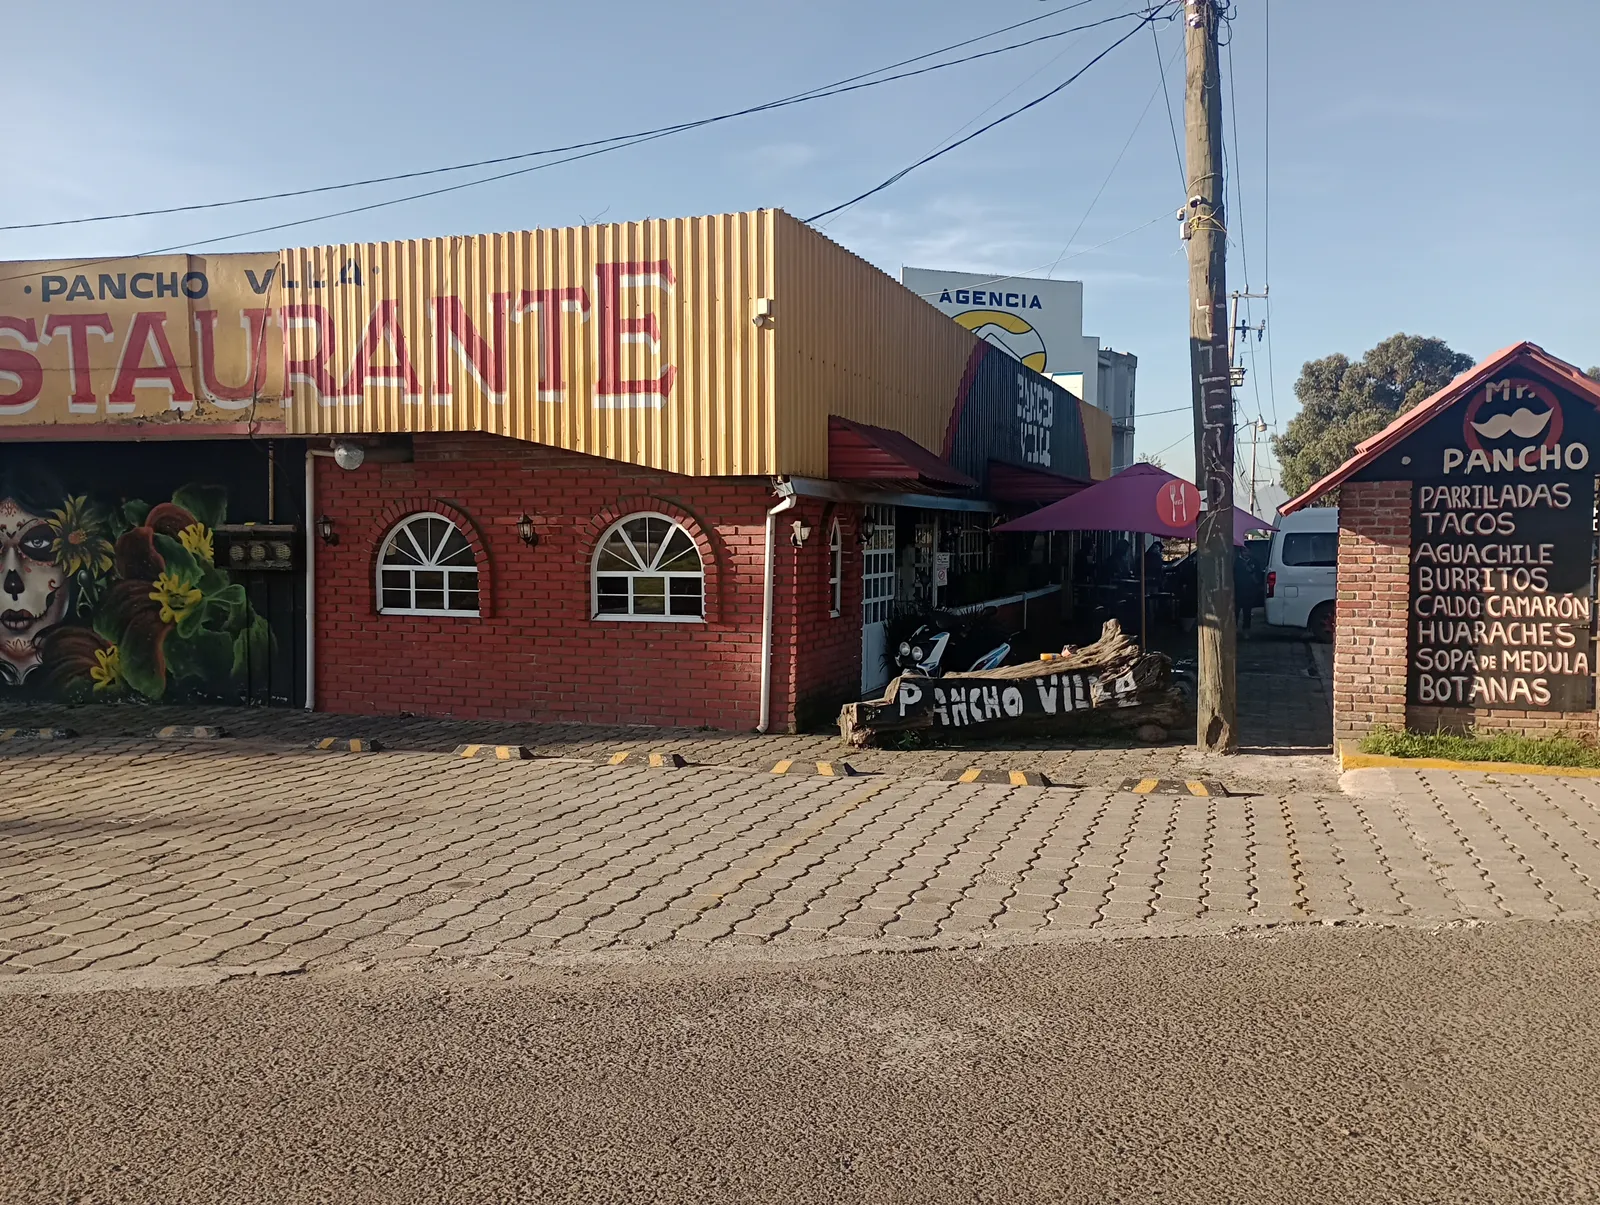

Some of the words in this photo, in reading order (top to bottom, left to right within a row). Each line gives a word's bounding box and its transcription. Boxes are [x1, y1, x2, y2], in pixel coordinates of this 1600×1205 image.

[42, 270, 209, 302] PANCHO
[243, 257, 364, 294] VLLA
[939, 289, 1042, 309] AGENCIA
[1485, 379, 1536, 403] Mr.
[1443, 442, 1589, 475] PANCHO
[1419, 483, 1572, 510] PARRILLADAS
[1421, 512, 1516, 535] TACOS
[1414, 542, 1555, 565] AGUACHILE
[1418, 566, 1549, 593] BURRITOS
[1414, 595, 1481, 618] CALDO
[1416, 620, 1577, 648] HUARACHES
[1415, 648, 1480, 673] SOPA
[1479, 654, 1498, 670] DE
[1501, 649, 1590, 676] MEDULA
[1418, 673, 1552, 706] BOTANAS
[899, 682, 1024, 726] PANCHO
